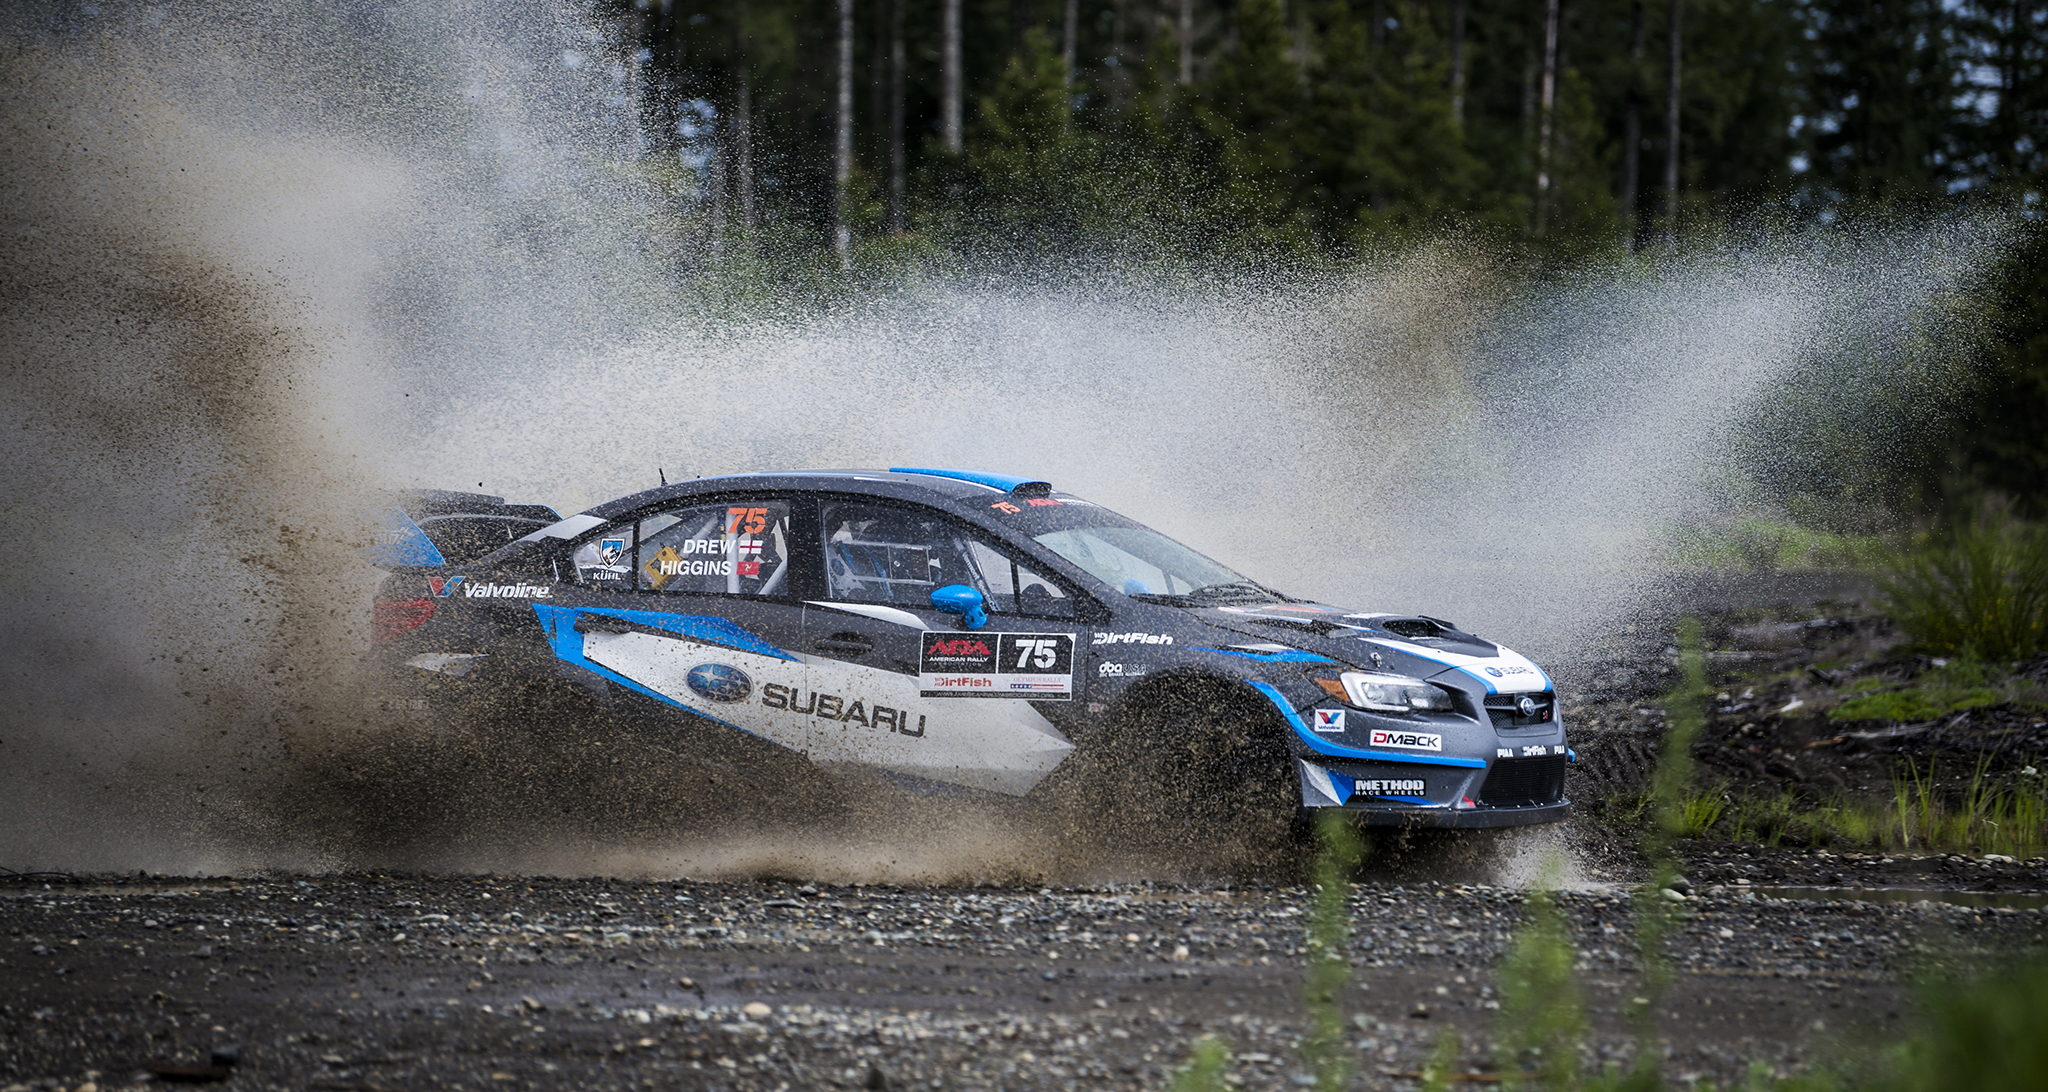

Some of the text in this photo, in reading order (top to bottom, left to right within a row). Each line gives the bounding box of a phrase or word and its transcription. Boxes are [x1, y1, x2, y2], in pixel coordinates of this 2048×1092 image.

[991, 501, 1021, 515] 75
[727, 507, 767, 535] 75
[683, 539, 737, 554] DREW
[593, 570, 621, 580] KÜHL
[660, 560, 732, 576] HIGGINS
[464, 582, 550, 598] Valvoline
[1091, 632, 1174, 645] DirtFish
[927, 640, 992, 655] ARA
[1015, 639, 1057, 669] 75
[1099, 661, 1147, 673] dba USA
[934, 677, 992, 687] DirtFish
[762, 682, 927, 738] SUBARU
[1496, 748, 1514, 758] PIAA
[1355, 780, 1425, 790] METHOD
